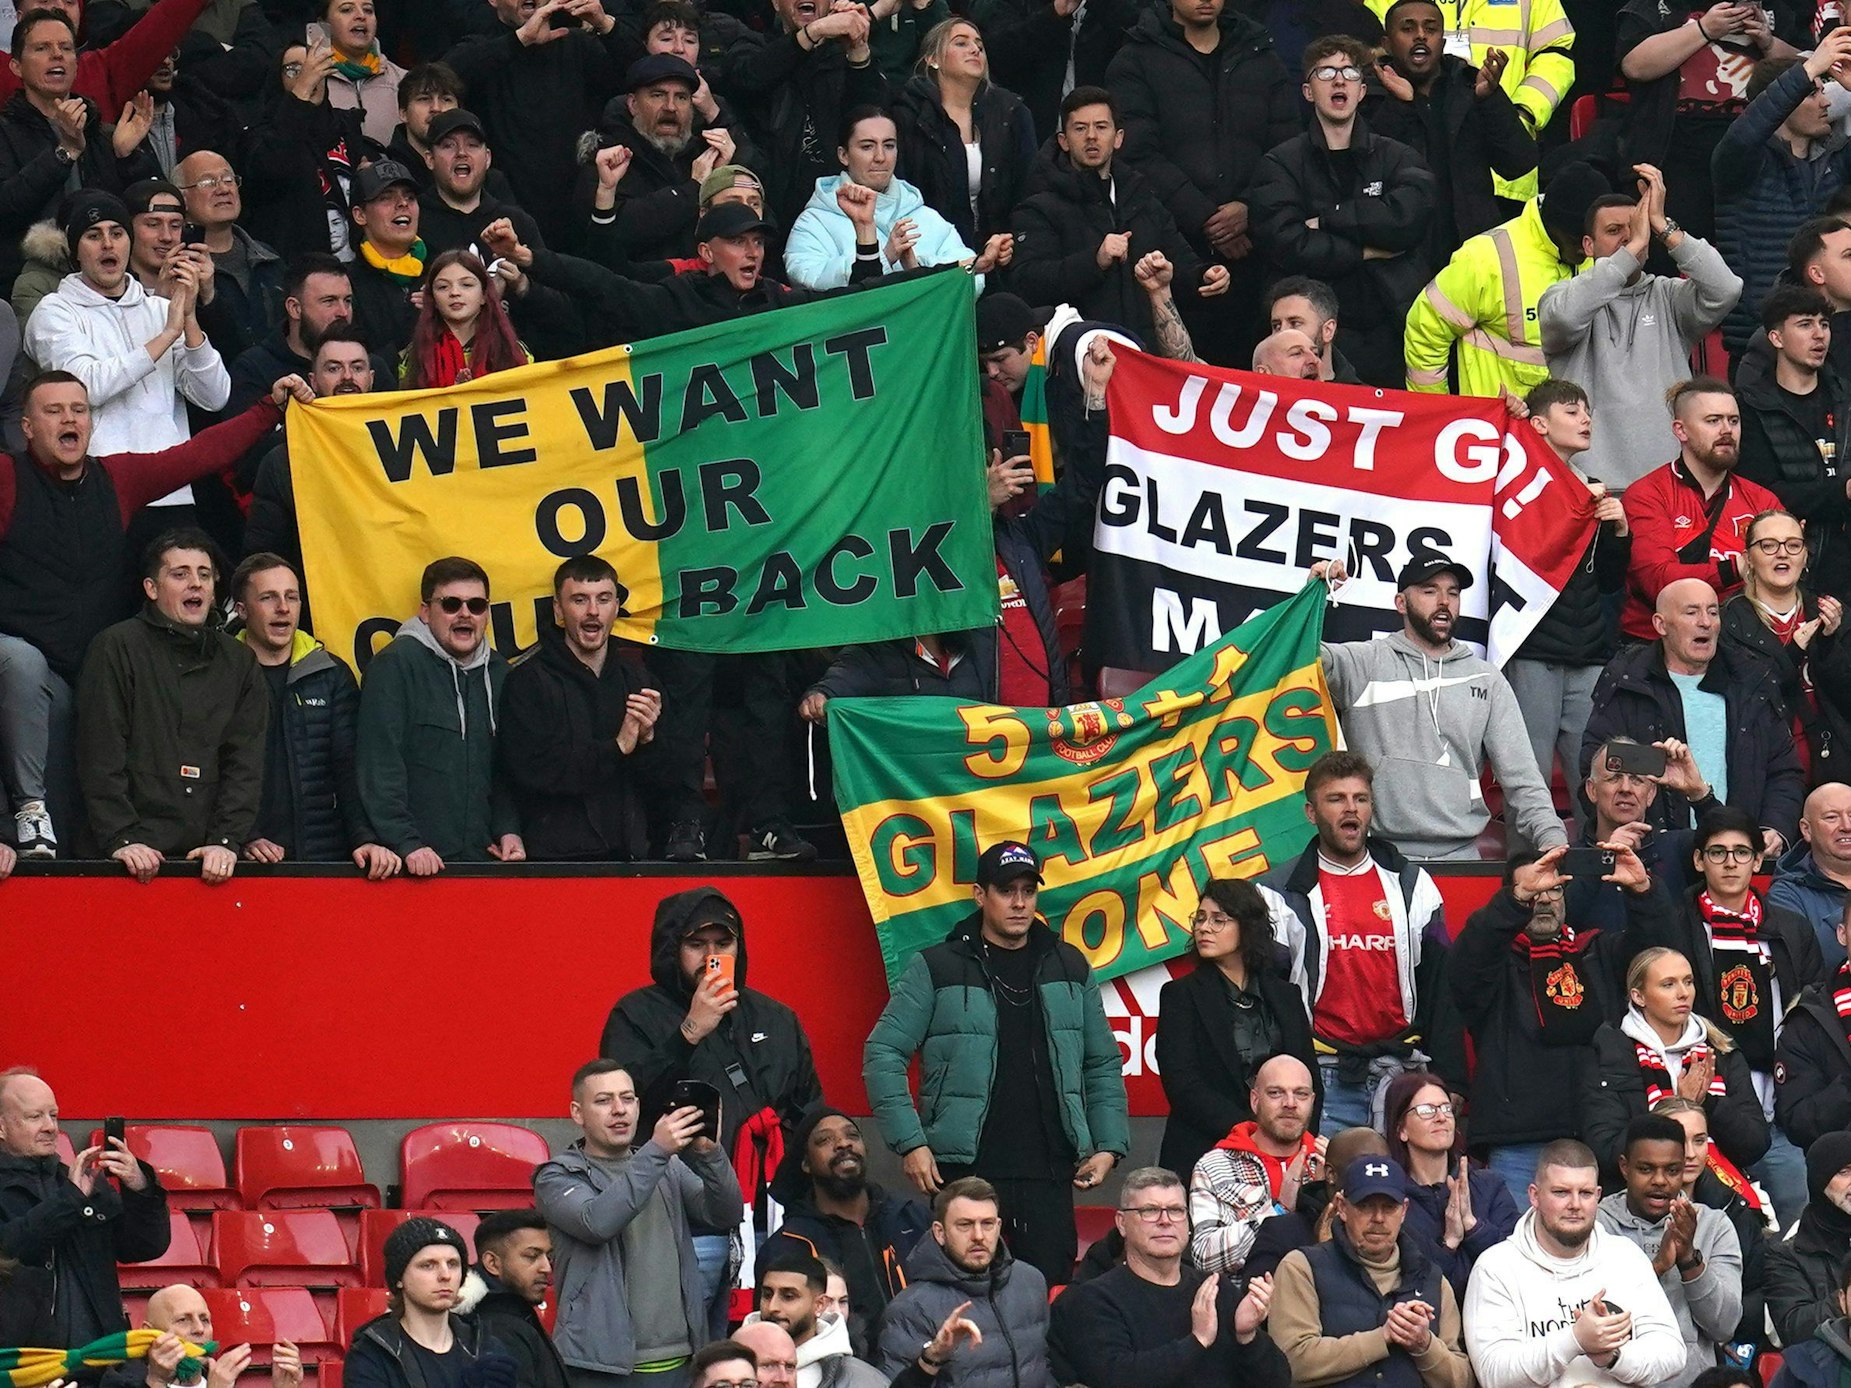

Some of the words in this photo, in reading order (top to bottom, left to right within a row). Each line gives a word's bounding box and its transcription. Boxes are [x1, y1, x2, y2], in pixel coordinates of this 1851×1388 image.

[365, 398, 538, 484] WE
[567, 325, 889, 452] WANT
[1152, 374, 1405, 472] JUST
[534, 458, 774, 560] OUR
[1099, 463, 1454, 584] GLAZERS
[678, 520, 966, 619] BACK
[956, 704, 1032, 780] 5
[1470, 686, 1488, 700] TM
[1056, 742, 1098, 760] FOOTBALL
[1034, 827, 1271, 970] ONE
[1327, 934, 1396, 952] HARP
